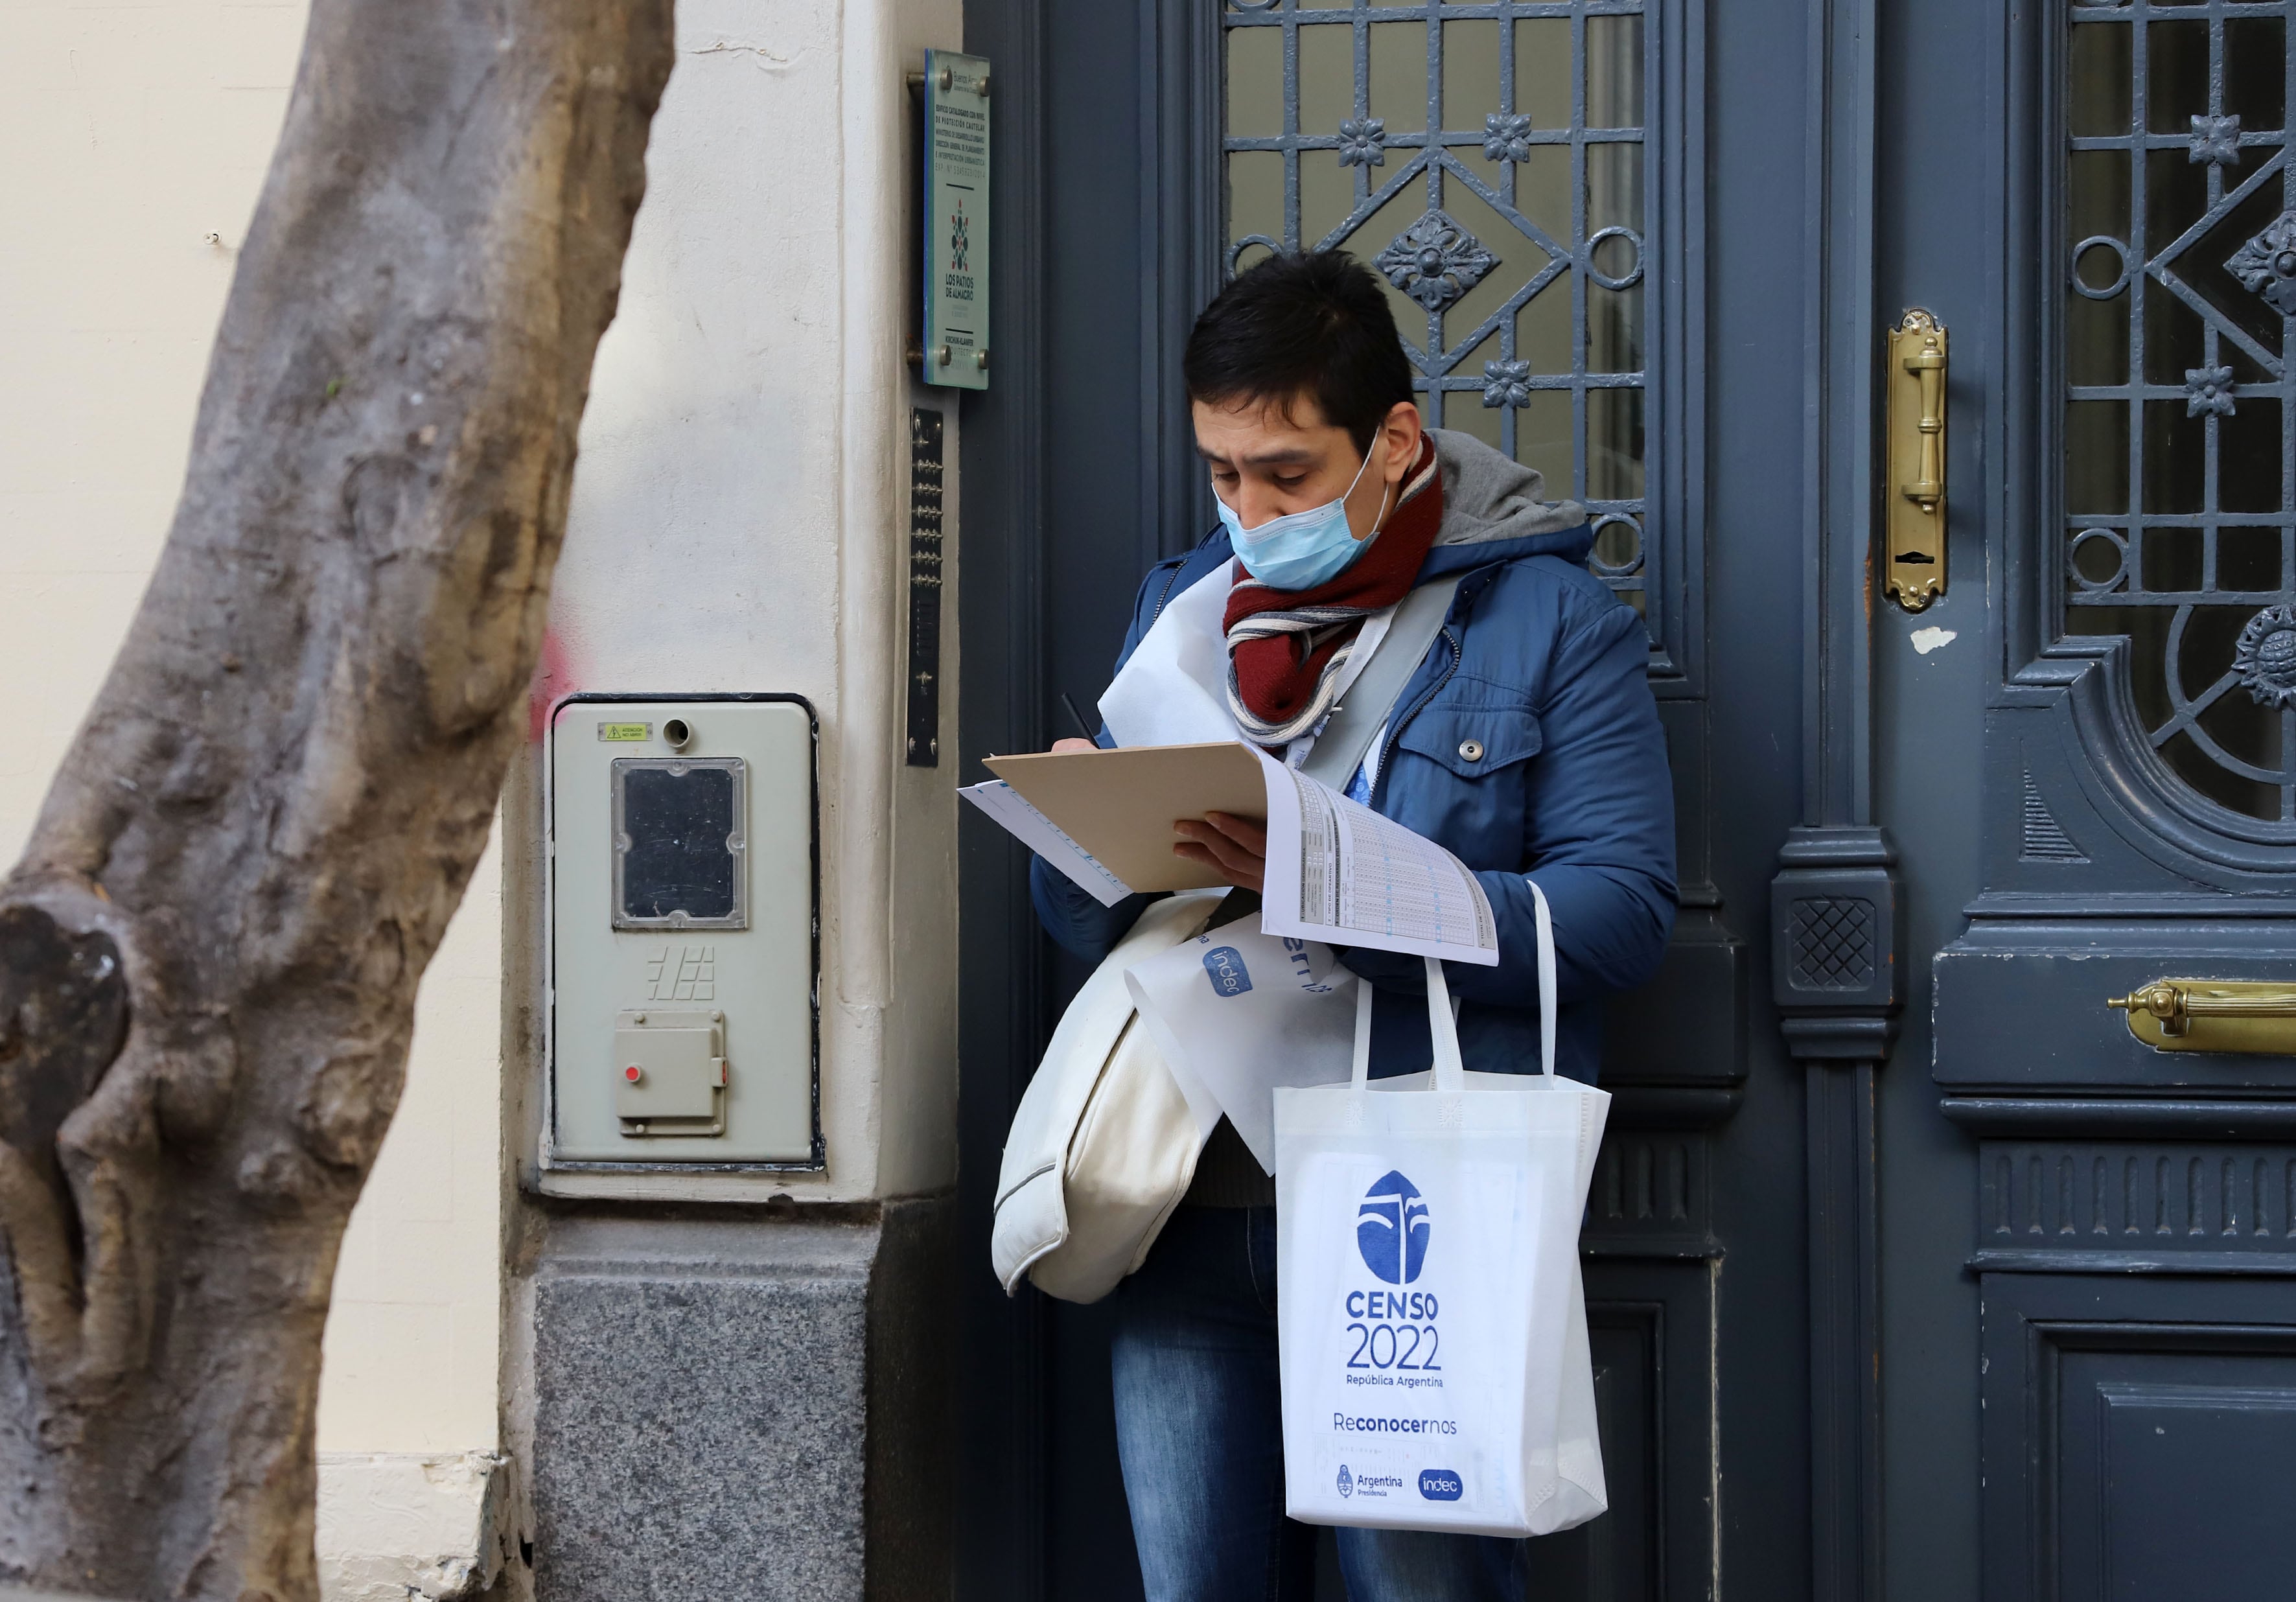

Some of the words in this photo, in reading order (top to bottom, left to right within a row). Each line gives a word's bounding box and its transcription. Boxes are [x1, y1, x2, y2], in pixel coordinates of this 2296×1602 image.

[936, 104, 948, 113] EDIFICIO
[949, 106, 969, 117] CATALOGADO
[977, 112, 985, 121] NIVEL
[942, 117, 965, 128] PROTECCIÓN
[966, 122, 985, 132] CAUTELAR
[945, 273, 955, 286] LOS
[956, 274, 974, 289] PATIOS
[945, 287, 952, 298] DE
[953, 288, 973, 301] ALMAGRO
[1212, 951, 1240, 992] indec
[1346, 1290, 1439, 1321] CENSO
[1347, 1323, 1441, 1371] 2022
[1347, 1374, 1393, 1387] República
[1397, 1376, 1443, 1388] Argentina
[1334, 1412, 1457, 1435] Reconocernos
[1358, 1475, 1402, 1489] Argentina
[1422, 1477, 1457, 1492] indec
